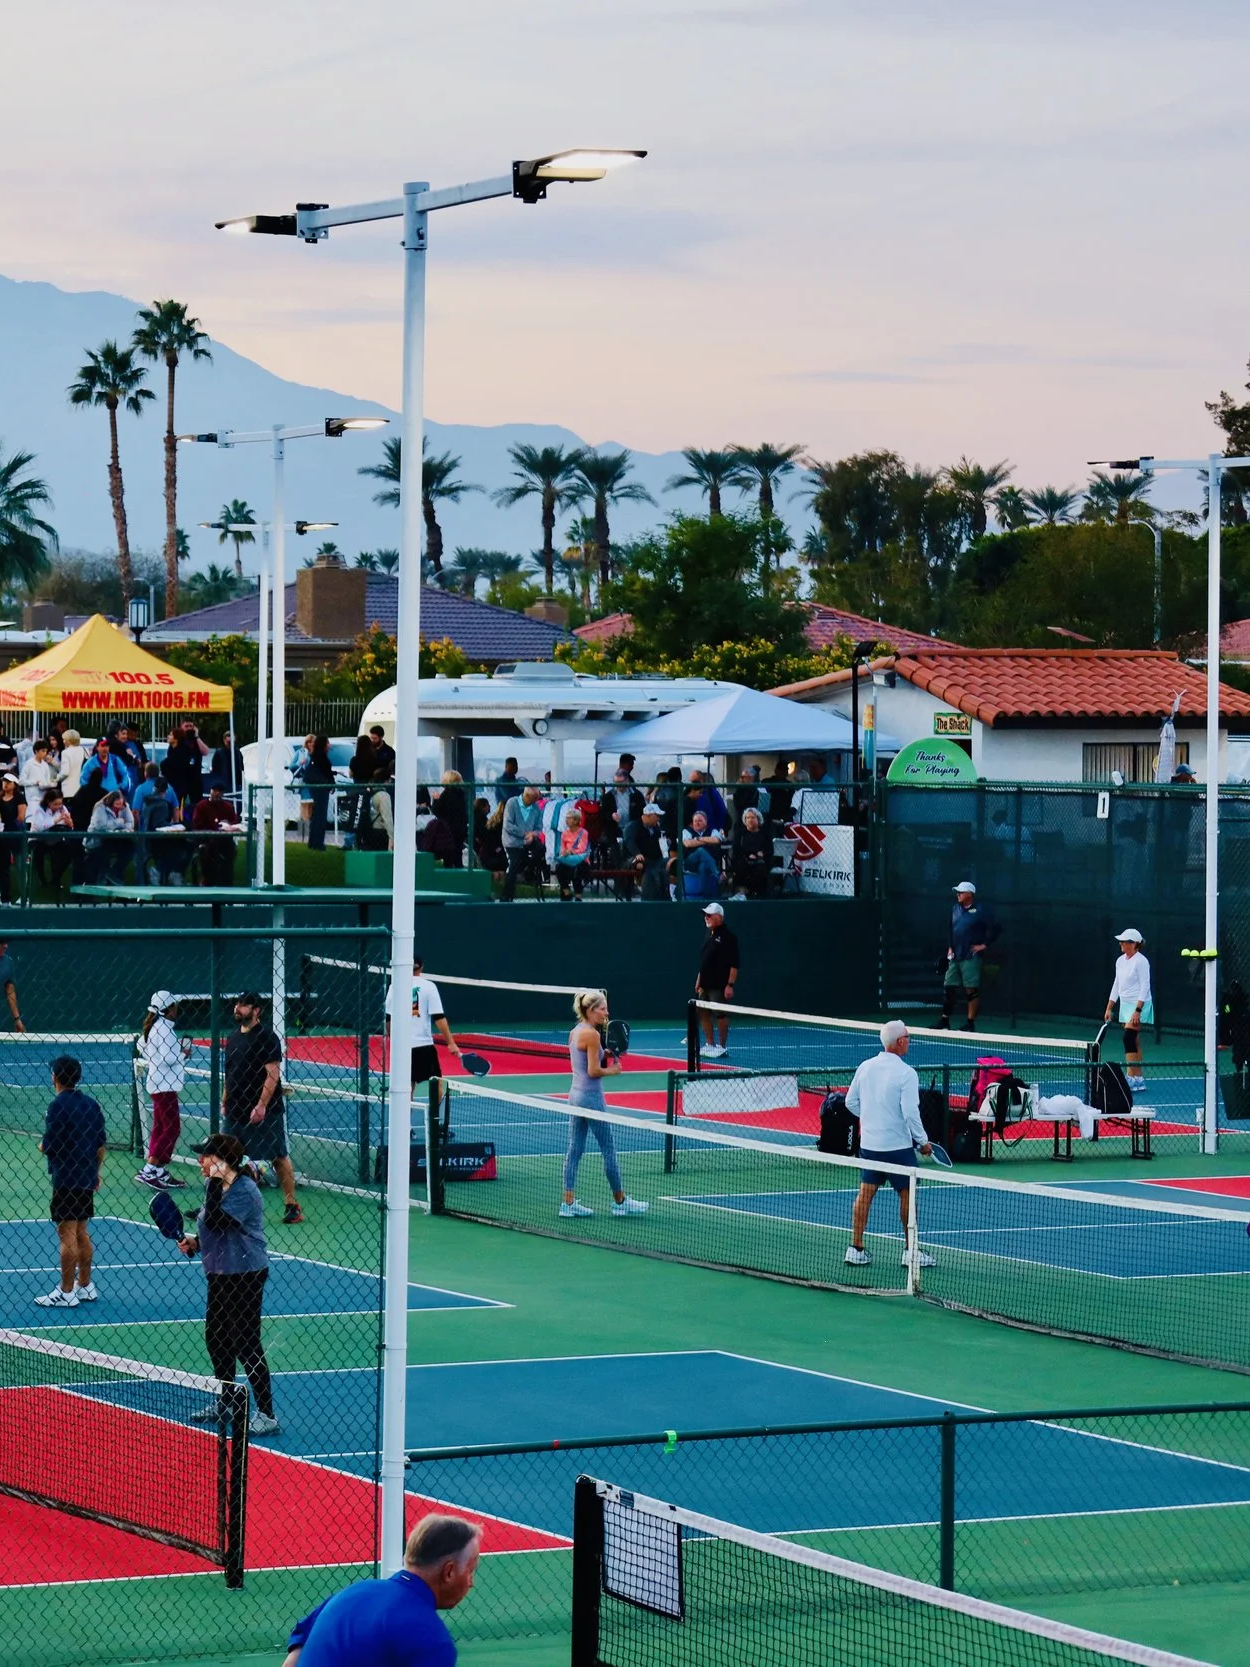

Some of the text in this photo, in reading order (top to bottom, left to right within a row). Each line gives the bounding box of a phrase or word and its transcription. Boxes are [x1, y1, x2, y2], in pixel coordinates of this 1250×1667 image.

[108, 671, 174, 685] 100.5
[61, 691, 210, 709] WWW.MIX1005.FM
[936, 717, 969, 731] The Shack
[915, 750, 946, 762] Thanks
[904, 763, 960, 777] For Playing
[1102, 796, 1106, 814] 1
[804, 868, 851, 882] SELKIRK
